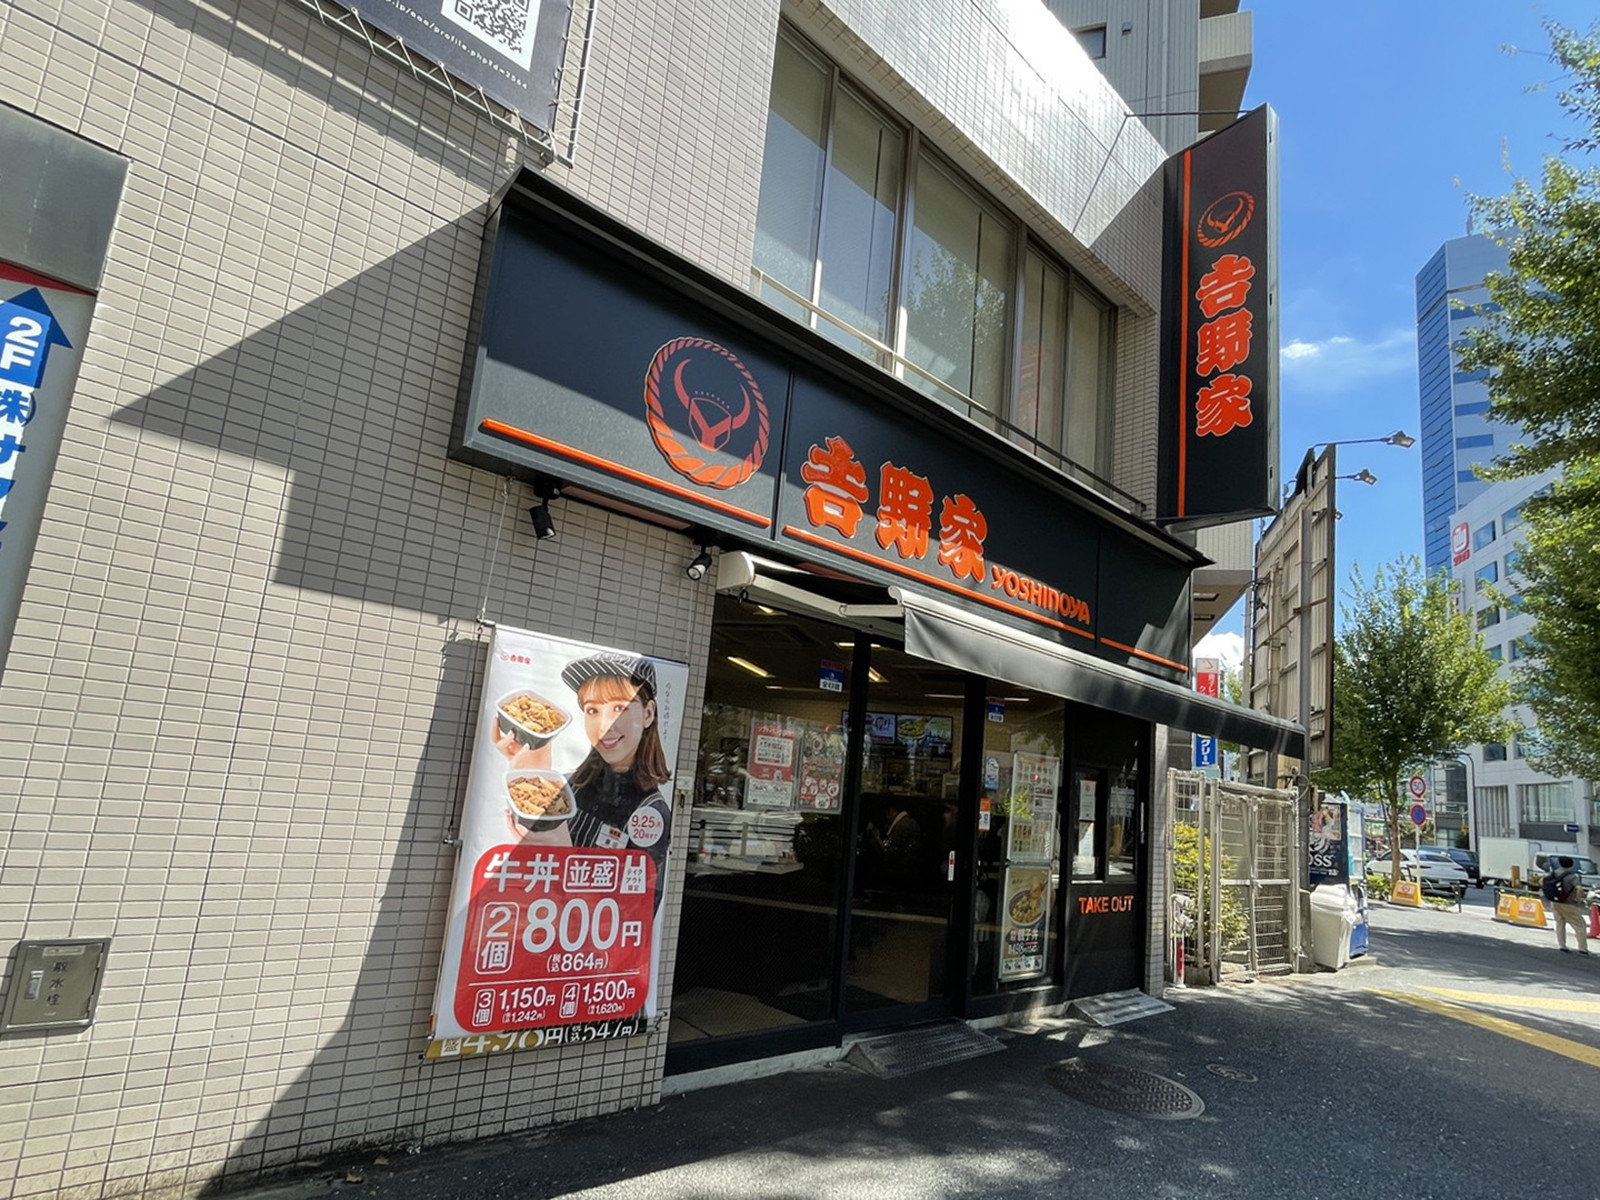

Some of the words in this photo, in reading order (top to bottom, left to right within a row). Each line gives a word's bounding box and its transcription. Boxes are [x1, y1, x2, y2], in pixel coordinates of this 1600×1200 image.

[1, 316, 42, 370] 2F
[801, 435, 988, 583] 吉野家
[991, 566, 1091, 625] YOSHINOYA
[1413, 781, 1422, 791] 50
[484, 852, 560, 893] 牛丼
[569, 860, 615, 888] 並盛
[627, 868, 643, 876] テイク
[1078, 896, 1109, 914] TAKE
[1111, 895, 1134, 912] OUT
[522, 897, 642, 954] 800円
[546, 951, 609, 973] (税込864円)
[499, 985, 556, 1012] 1,150円
[582, 979, 636, 1005] 1,500円
